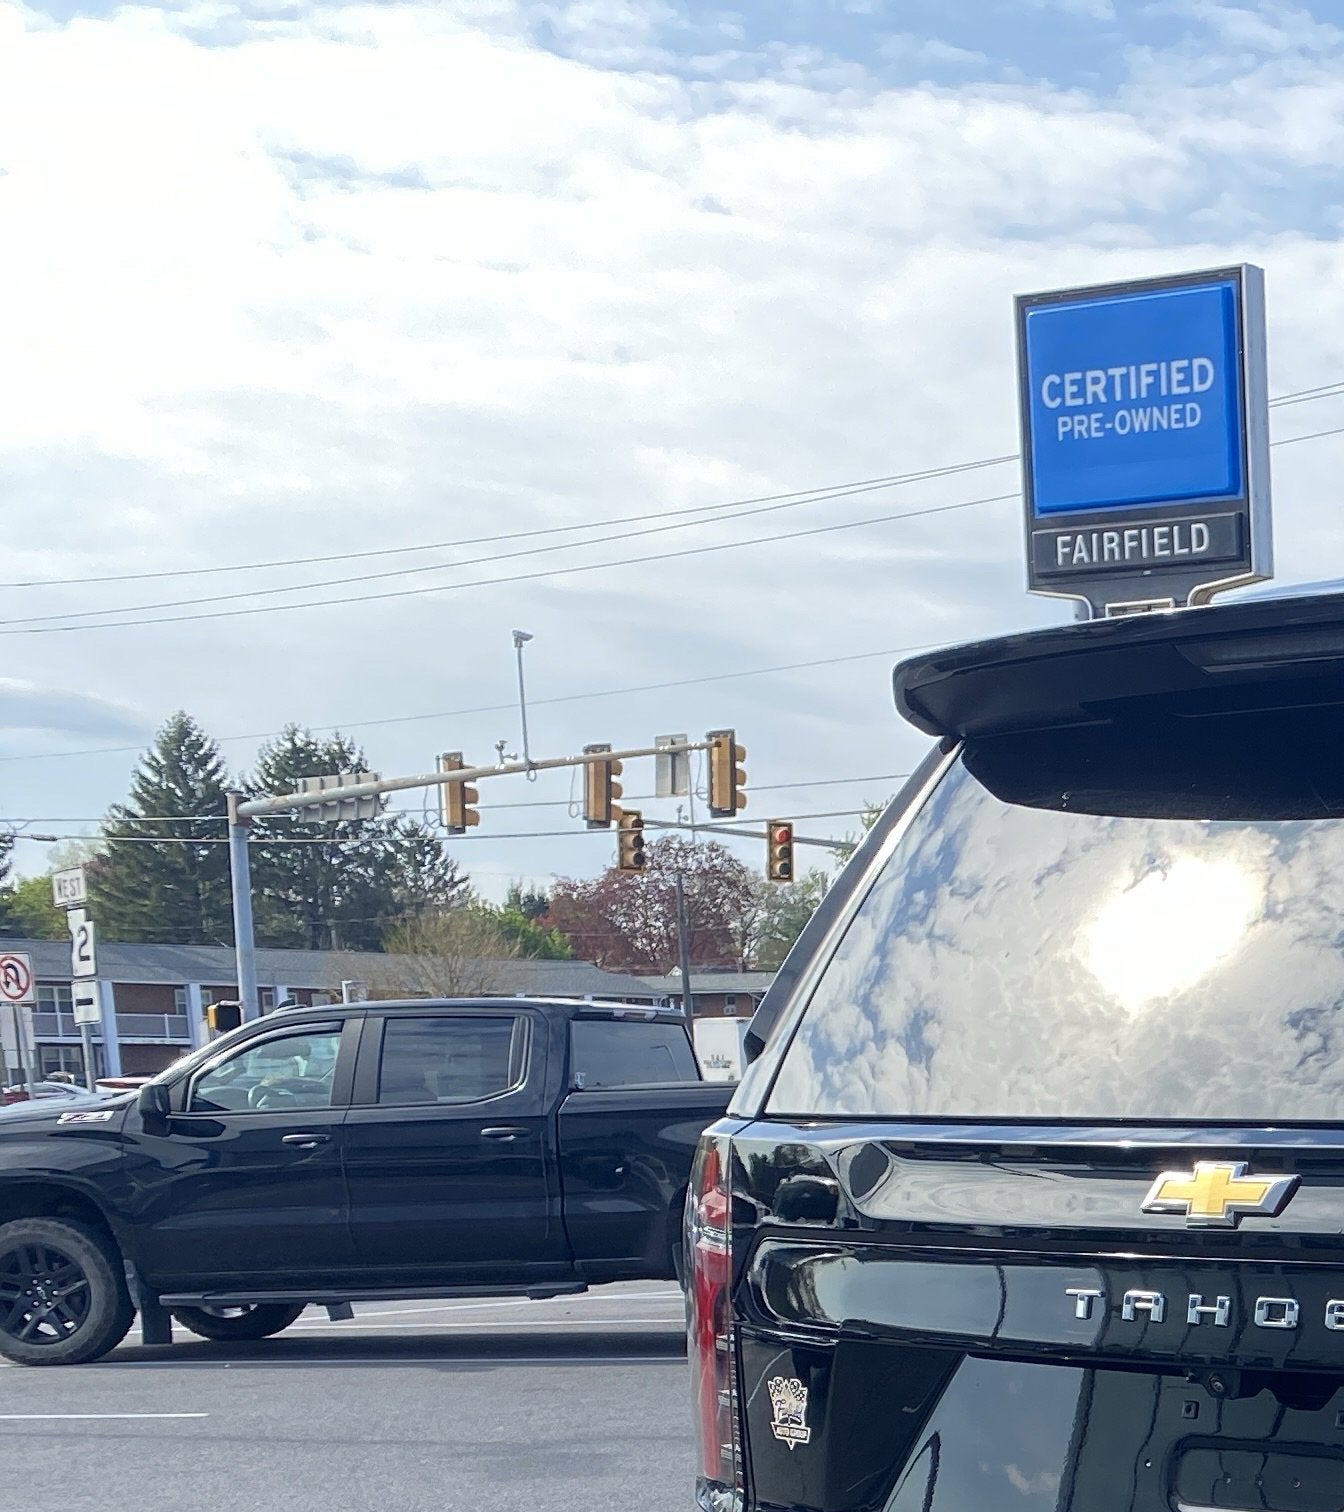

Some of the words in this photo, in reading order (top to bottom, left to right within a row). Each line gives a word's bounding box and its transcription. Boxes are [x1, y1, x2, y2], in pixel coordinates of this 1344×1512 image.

[1041, 357, 1215, 409] CERTIFIED
[1057, 403, 1202, 441] PRE-OWNED
[1056, 522, 1211, 566] FAIRFIELD
[56, 877, 81, 898] WEST
